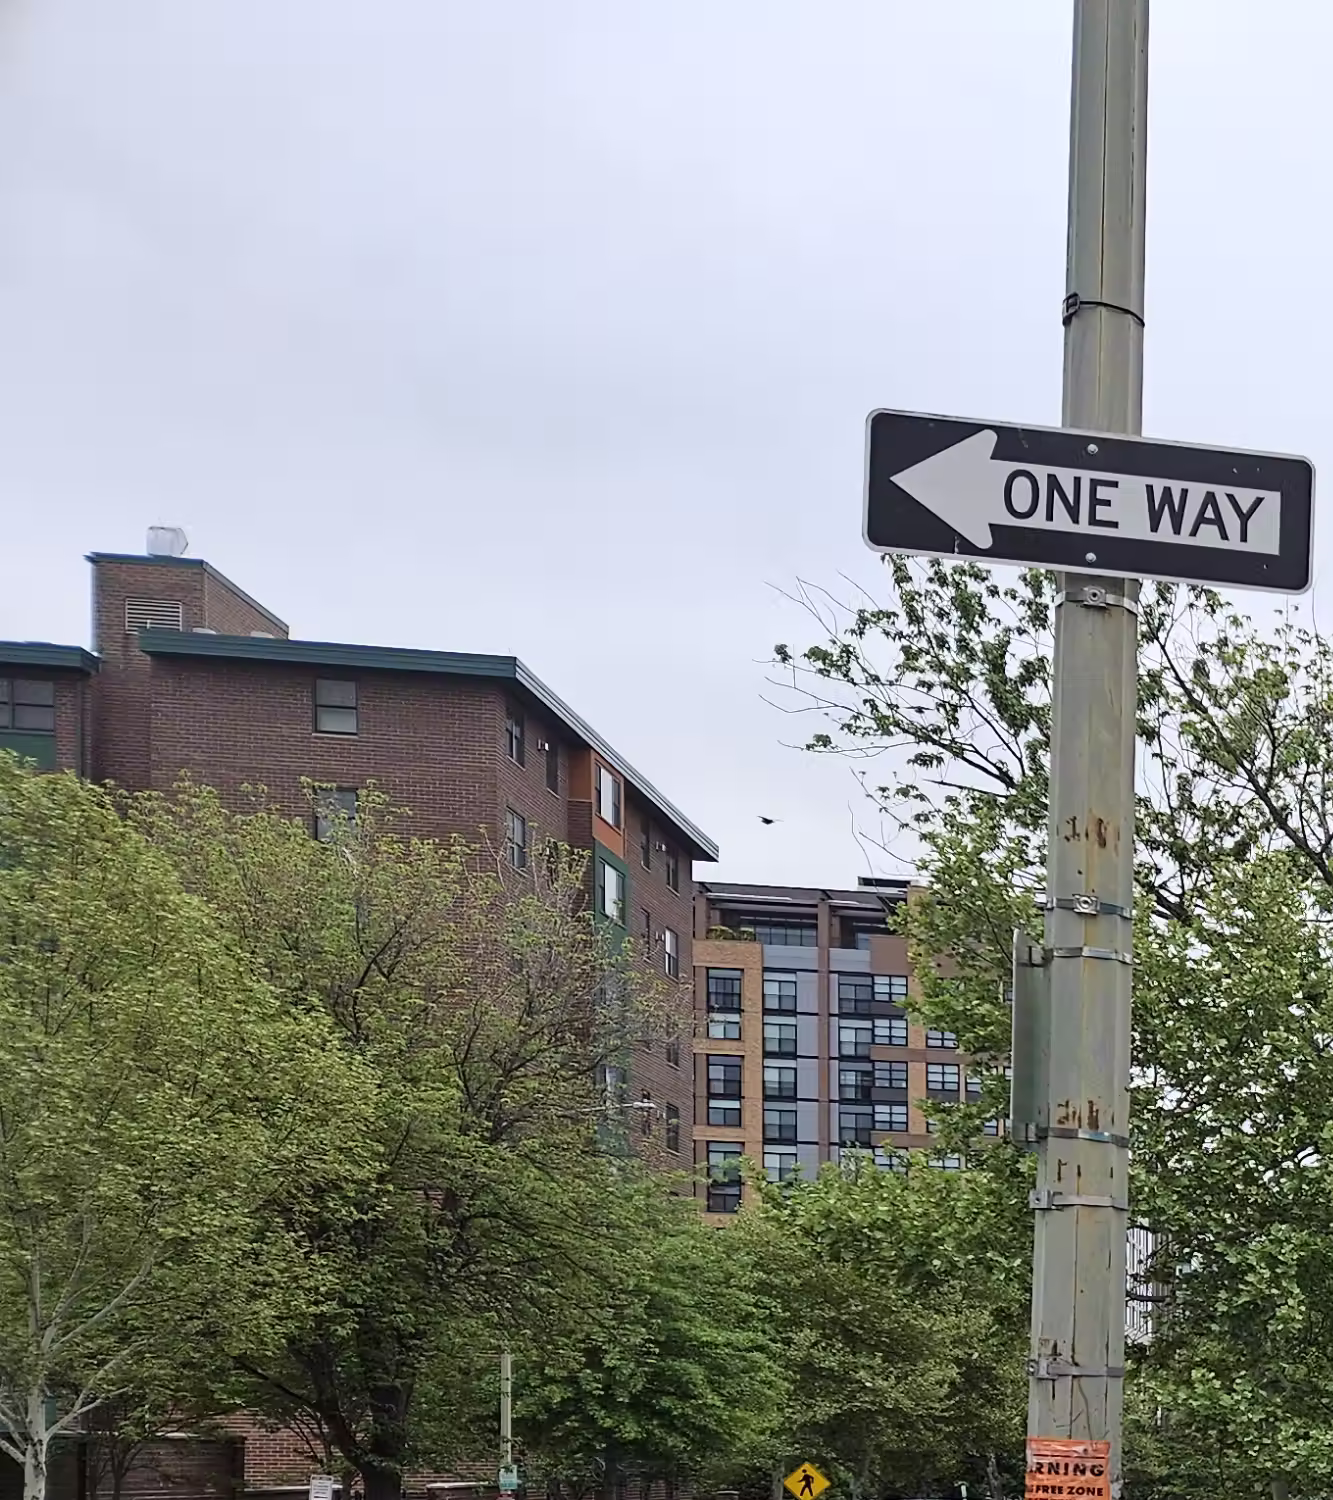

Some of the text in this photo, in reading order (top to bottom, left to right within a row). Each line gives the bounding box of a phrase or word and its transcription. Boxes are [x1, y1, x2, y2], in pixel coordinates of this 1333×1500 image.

[1003, 469, 1265, 543] ONE WAY
[1035, 1485, 1064, 1495] FREE
[1067, 1487, 1104, 1497] ZONE
